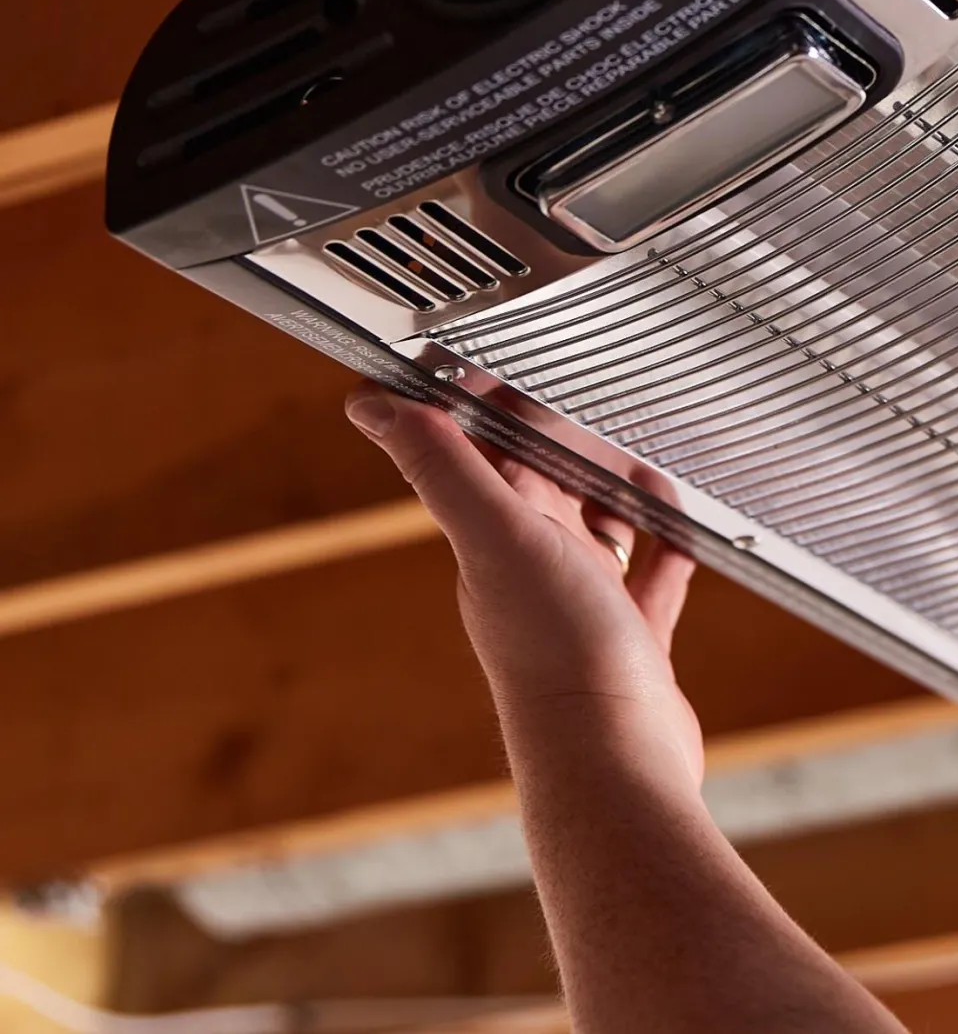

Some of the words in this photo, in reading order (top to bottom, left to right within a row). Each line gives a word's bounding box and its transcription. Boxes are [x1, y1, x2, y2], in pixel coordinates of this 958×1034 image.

[321, 126, 401, 166] CAUTION
[400, 105, 447, 132] RISK
[445, 90, 471, 109] OF
[471, 40, 562, 95] ELECTRIC
[559, 0, 628, 44] SHOCK
[335, 160, 367, 178] NO
[538, 36, 601, 76] PARTS
[448, 123, 526, 168] AUCUNE
[687, 0, 729, 29] PAR
[536, 86, 568, 107] DE
[565, 54, 622, 90] CHOC
